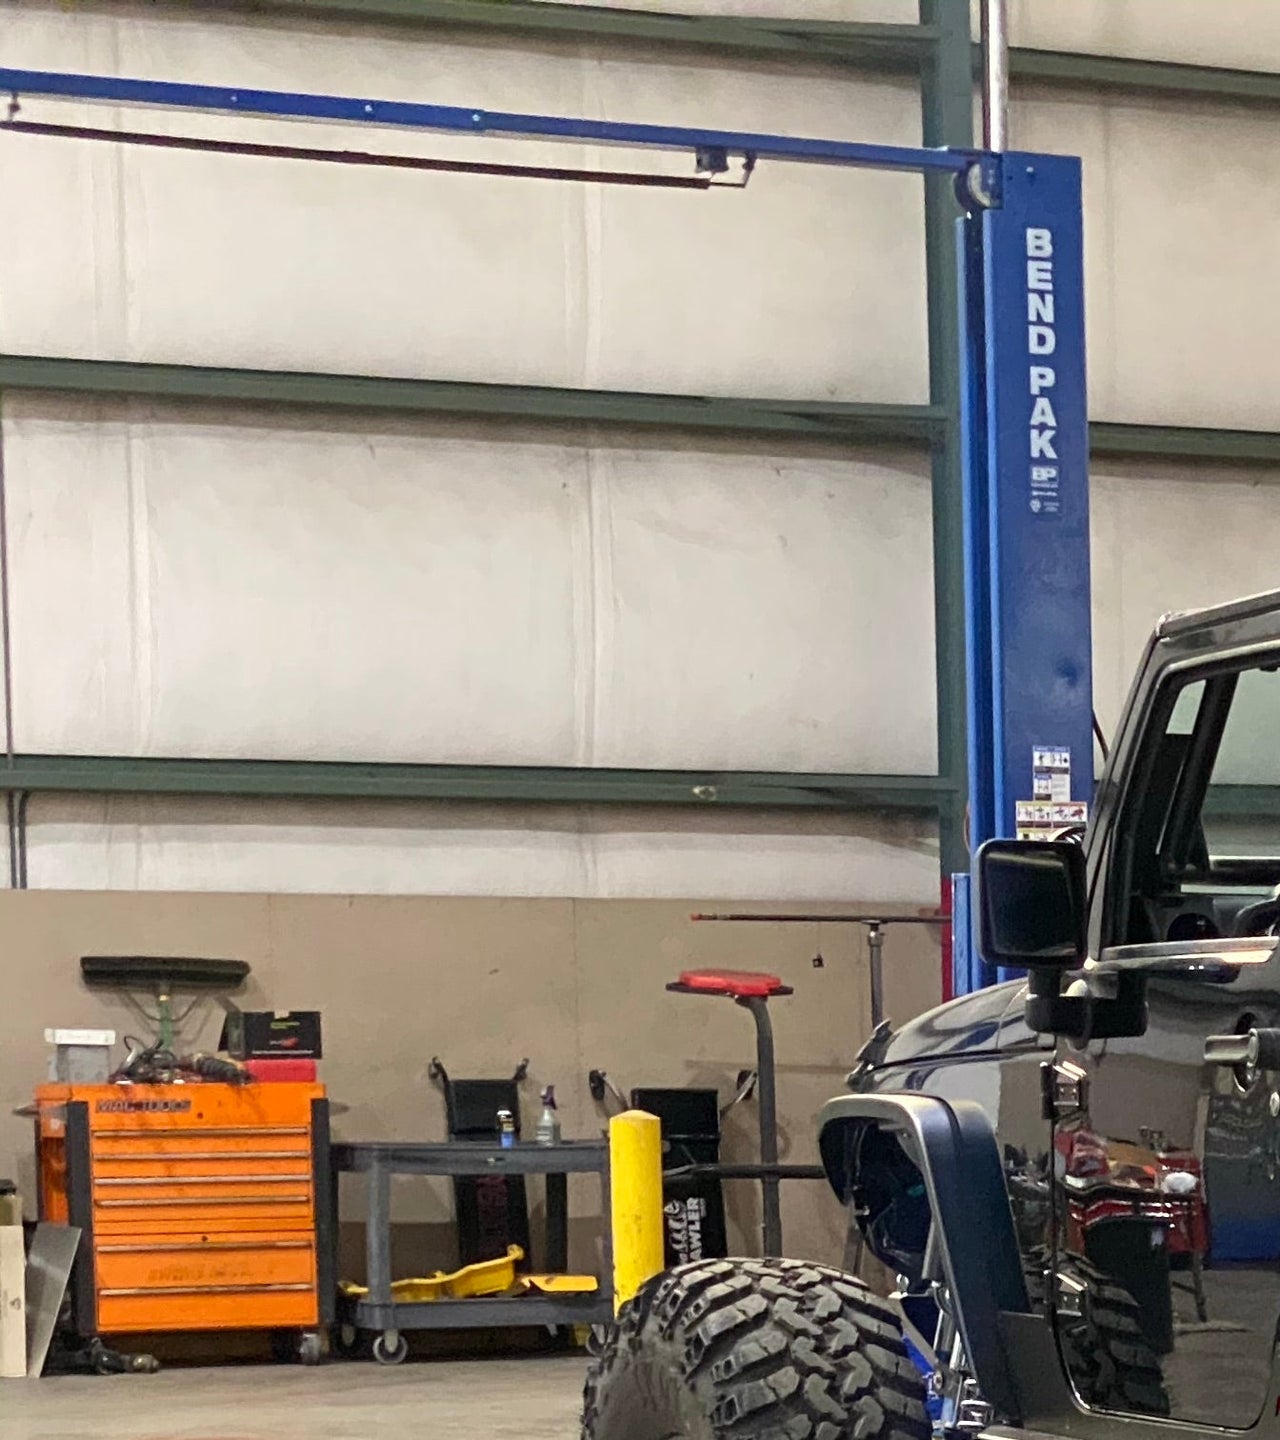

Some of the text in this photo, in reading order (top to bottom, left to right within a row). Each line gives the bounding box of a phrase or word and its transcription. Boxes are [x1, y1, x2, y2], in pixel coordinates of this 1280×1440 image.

[1026, 227, 1056, 355] BEND
[1029, 365, 1058, 460] PAK
[687, 1197, 701, 1261] AWLER
